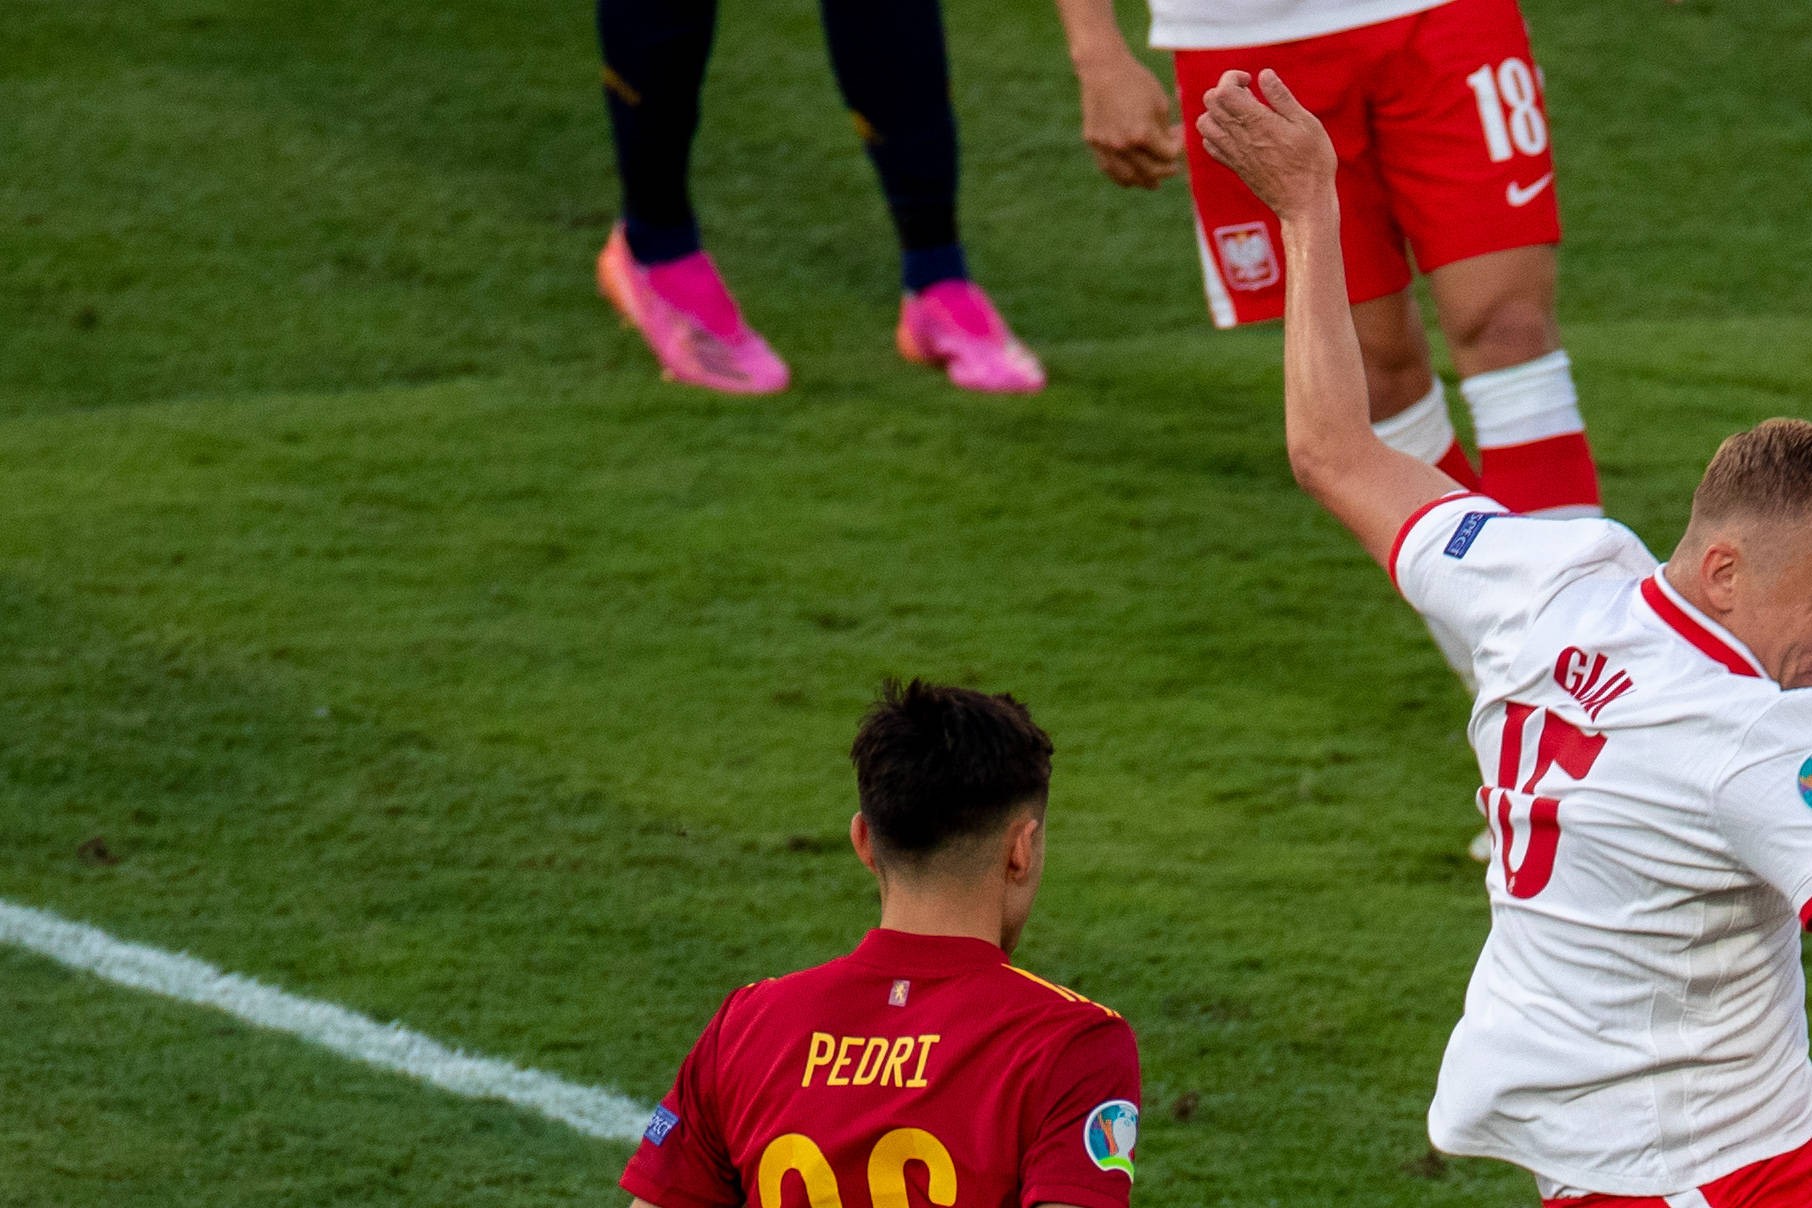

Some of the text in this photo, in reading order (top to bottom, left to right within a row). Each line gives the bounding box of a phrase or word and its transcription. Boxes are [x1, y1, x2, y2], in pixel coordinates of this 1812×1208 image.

[1467, 56, 1548, 163] 18
[1451, 513, 1484, 556] SPECT
[801, 1031, 940, 1088] PEDRI
